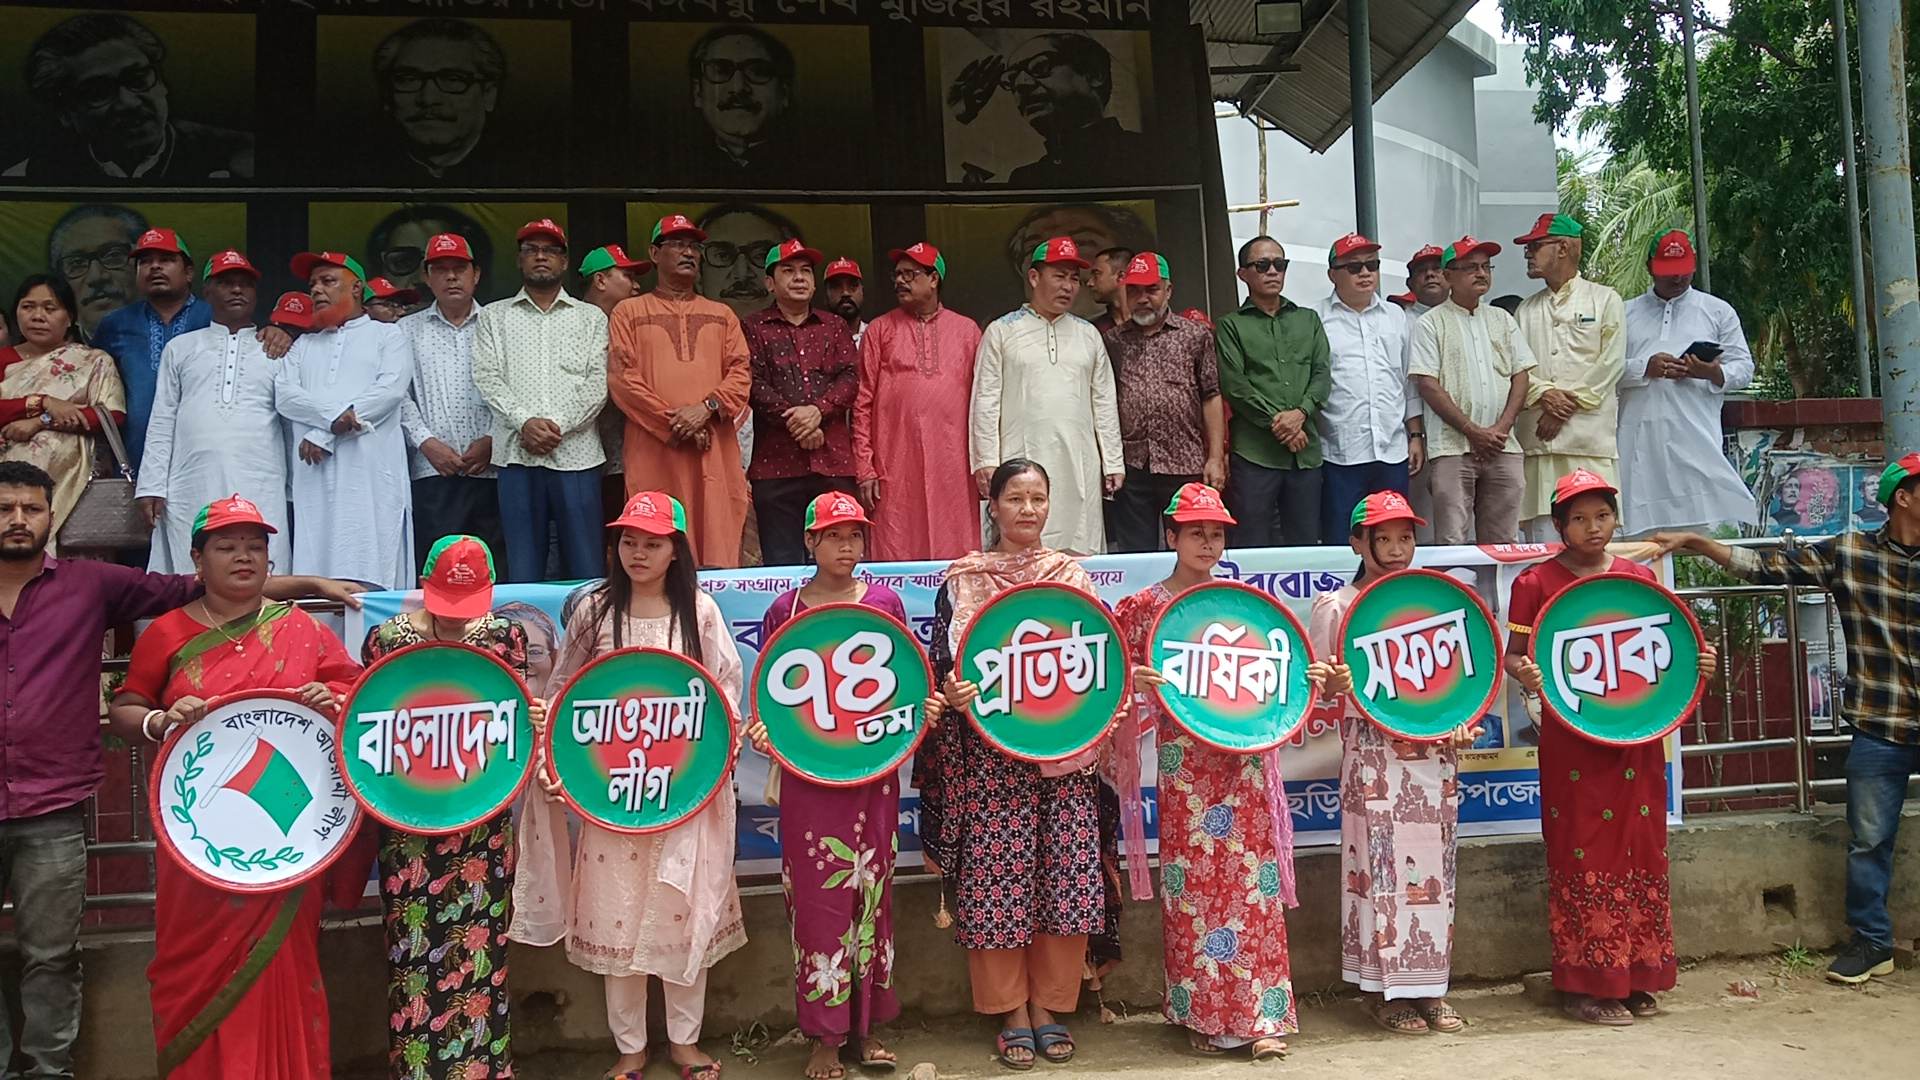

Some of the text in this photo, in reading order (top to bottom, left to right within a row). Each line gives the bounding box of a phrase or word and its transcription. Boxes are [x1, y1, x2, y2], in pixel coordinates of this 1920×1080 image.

[733, 578, 792, 592] সংগ্রামে
[766, 630, 898, 731] ৭৪
[854, 703, 916, 745] তম
[973, 618, 1109, 717] প্রতিষ্ঠা
[1161, 622, 1292, 706] বার্ষিকী
[1353, 608, 1476, 702] সফল
[1551, 612, 1673, 714] হোক
[221, 708, 315, 735] বাংলাদেশ
[357, 699, 519, 782] বাংলাদেশ
[572, 677, 708, 749] আওয়ামী
[608, 748, 672, 812] লীগ
